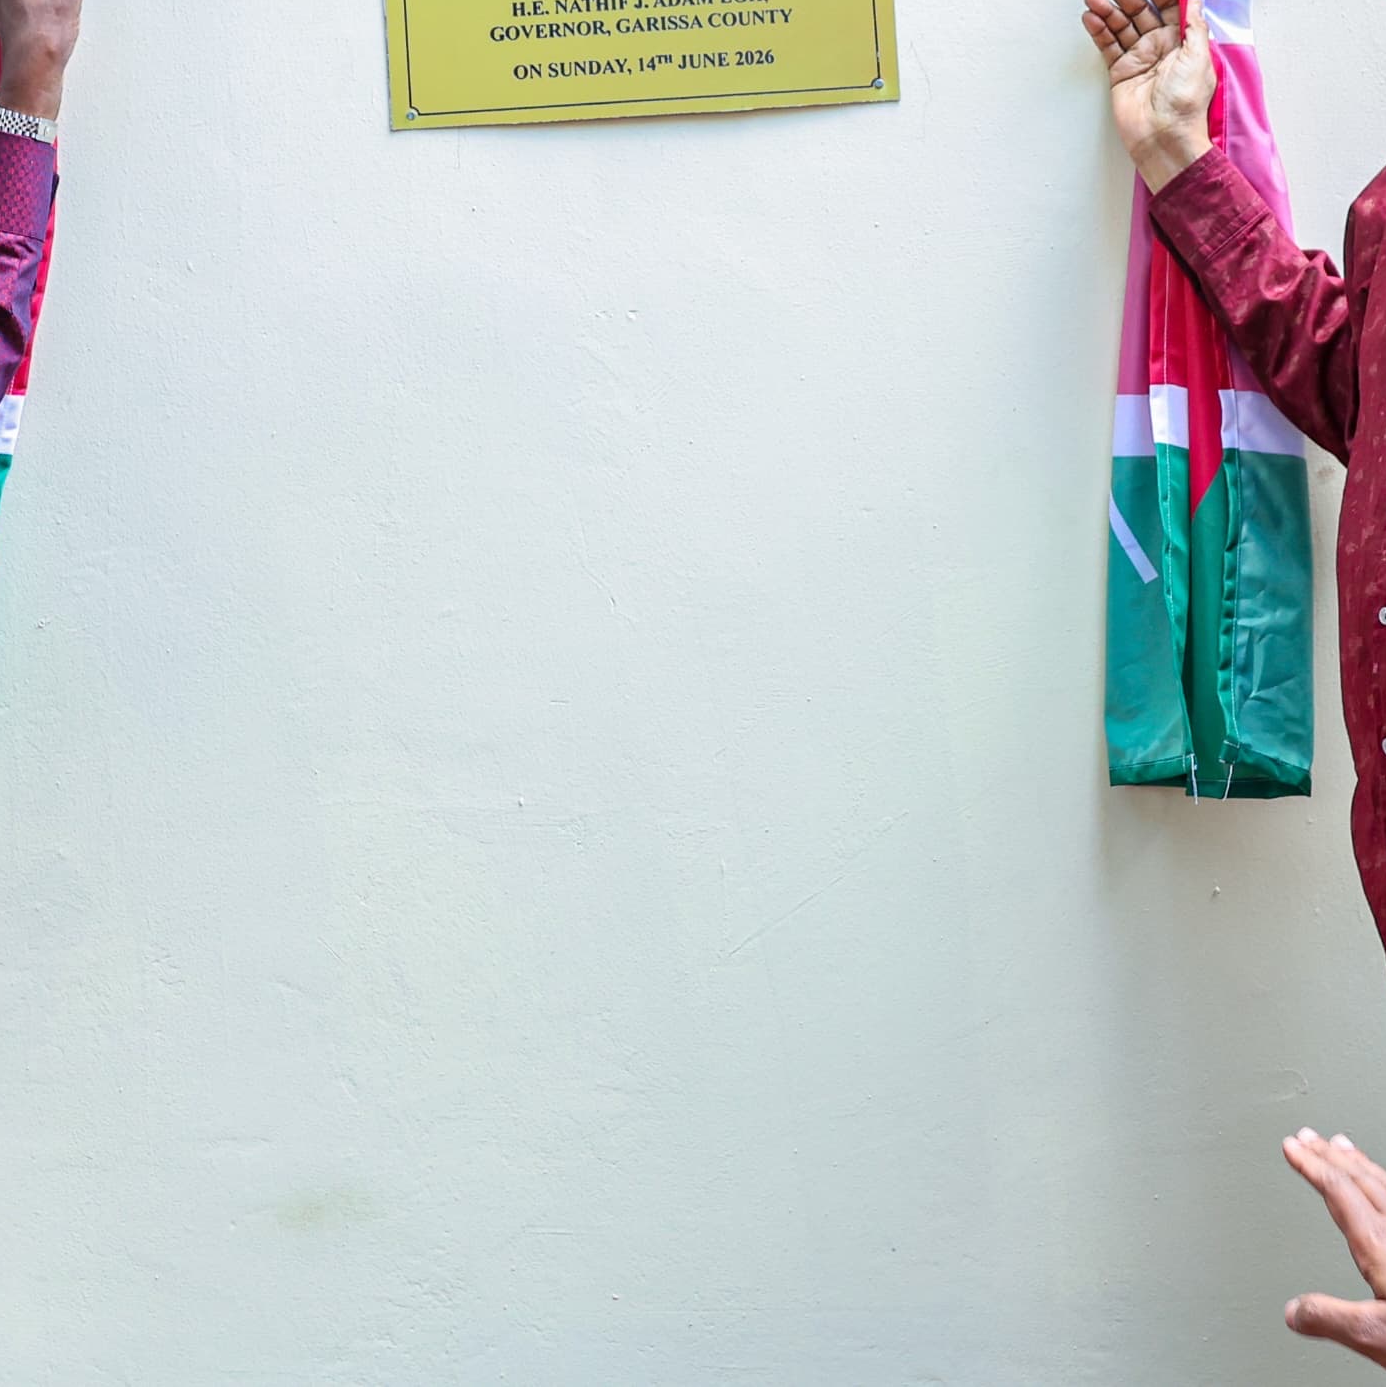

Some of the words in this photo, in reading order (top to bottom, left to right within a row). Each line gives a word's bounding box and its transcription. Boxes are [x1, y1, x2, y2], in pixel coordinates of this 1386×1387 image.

[512, 0, 550, 17] H.E.
[489, 20, 611, 42] GOVERNOR,
[616, 15, 703, 34] GARISSA
[707, 8, 792, 28] COUNTY
[513, 63, 542, 80] ON
[548, 58, 632, 78] SUNDAY,
[678, 52, 730, 70] JUNE
[735, 49, 775, 66] 2026
